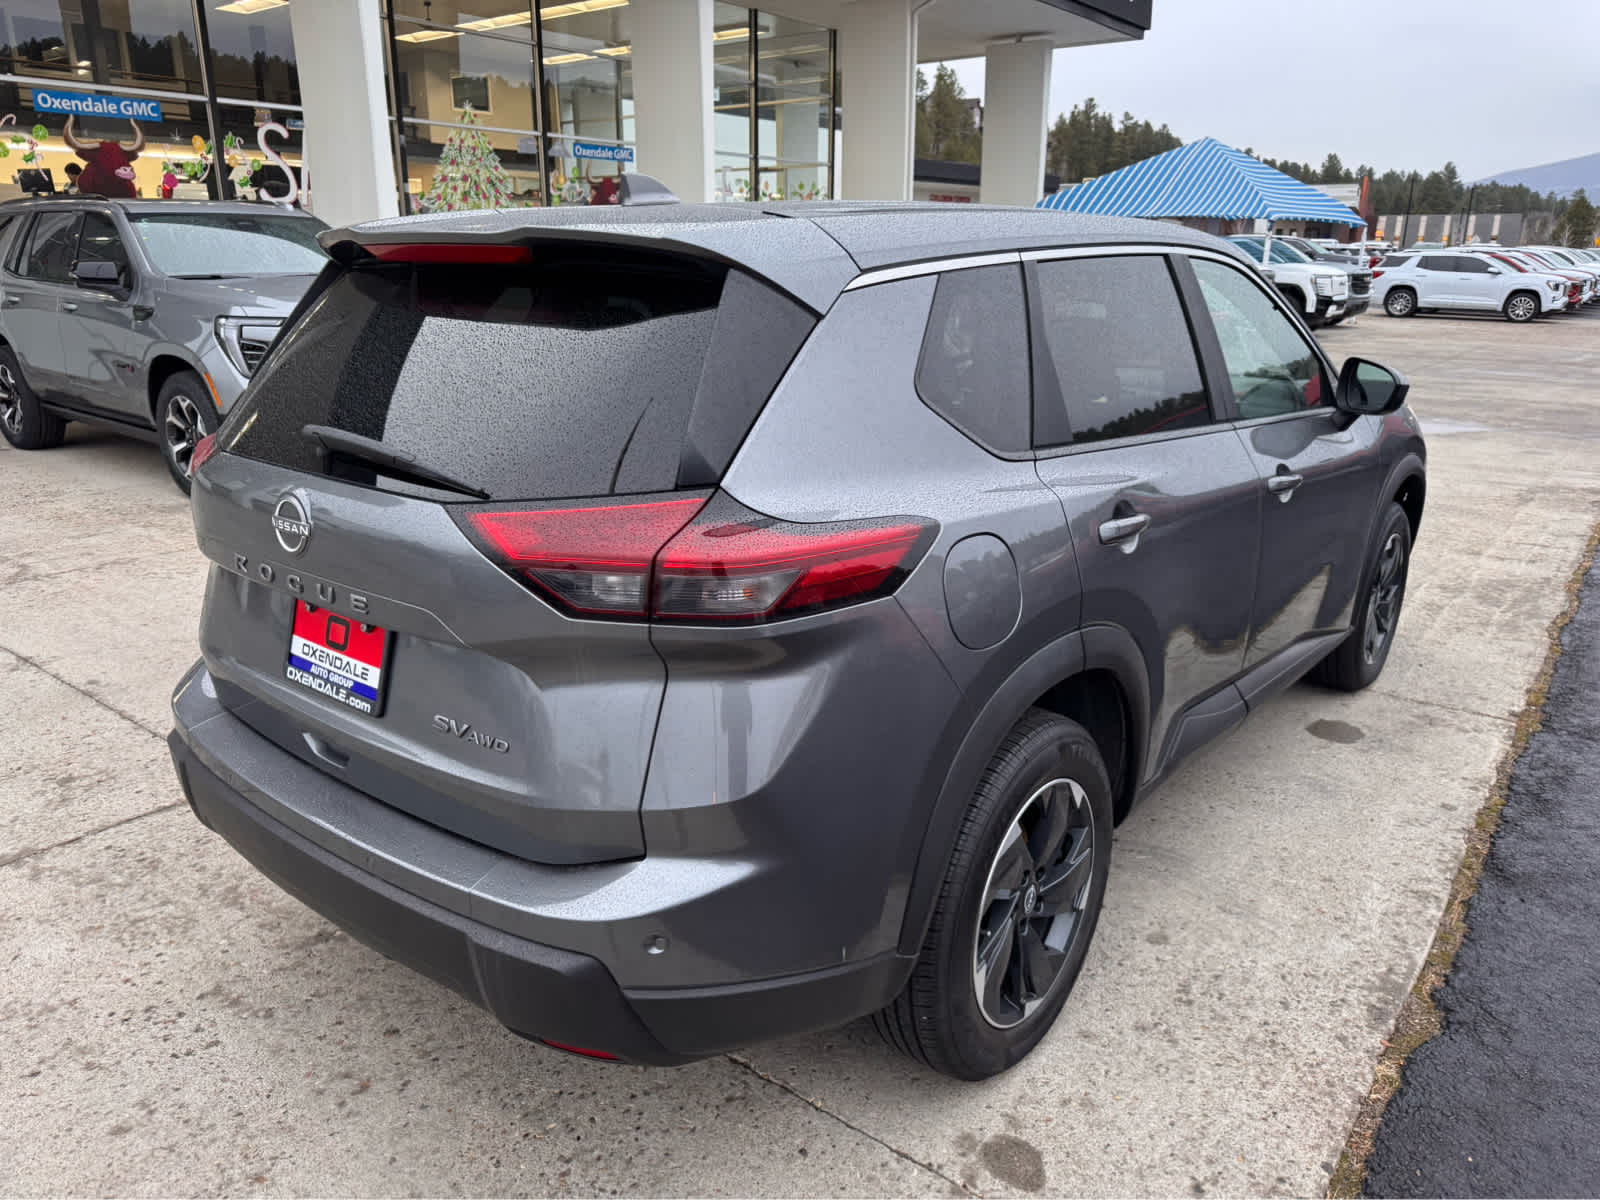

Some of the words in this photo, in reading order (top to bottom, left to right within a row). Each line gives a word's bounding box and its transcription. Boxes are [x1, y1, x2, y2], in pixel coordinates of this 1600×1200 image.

[37, 93, 119, 114] Oxendale
[120, 101, 158, 117] GMC
[575, 145, 613, 158] Oxendale
[272, 517, 309, 536] NISSAN
[234, 553, 369, 615] ROGUE
[302, 643, 370, 681] OXENDALE
[310, 664, 329, 679] AUTO
[329, 672, 354, 688] GROUP
[286, 666, 371, 713] OXENDALE.com
[432, 714, 471, 738] SV
[467, 730, 510, 753] AWD
